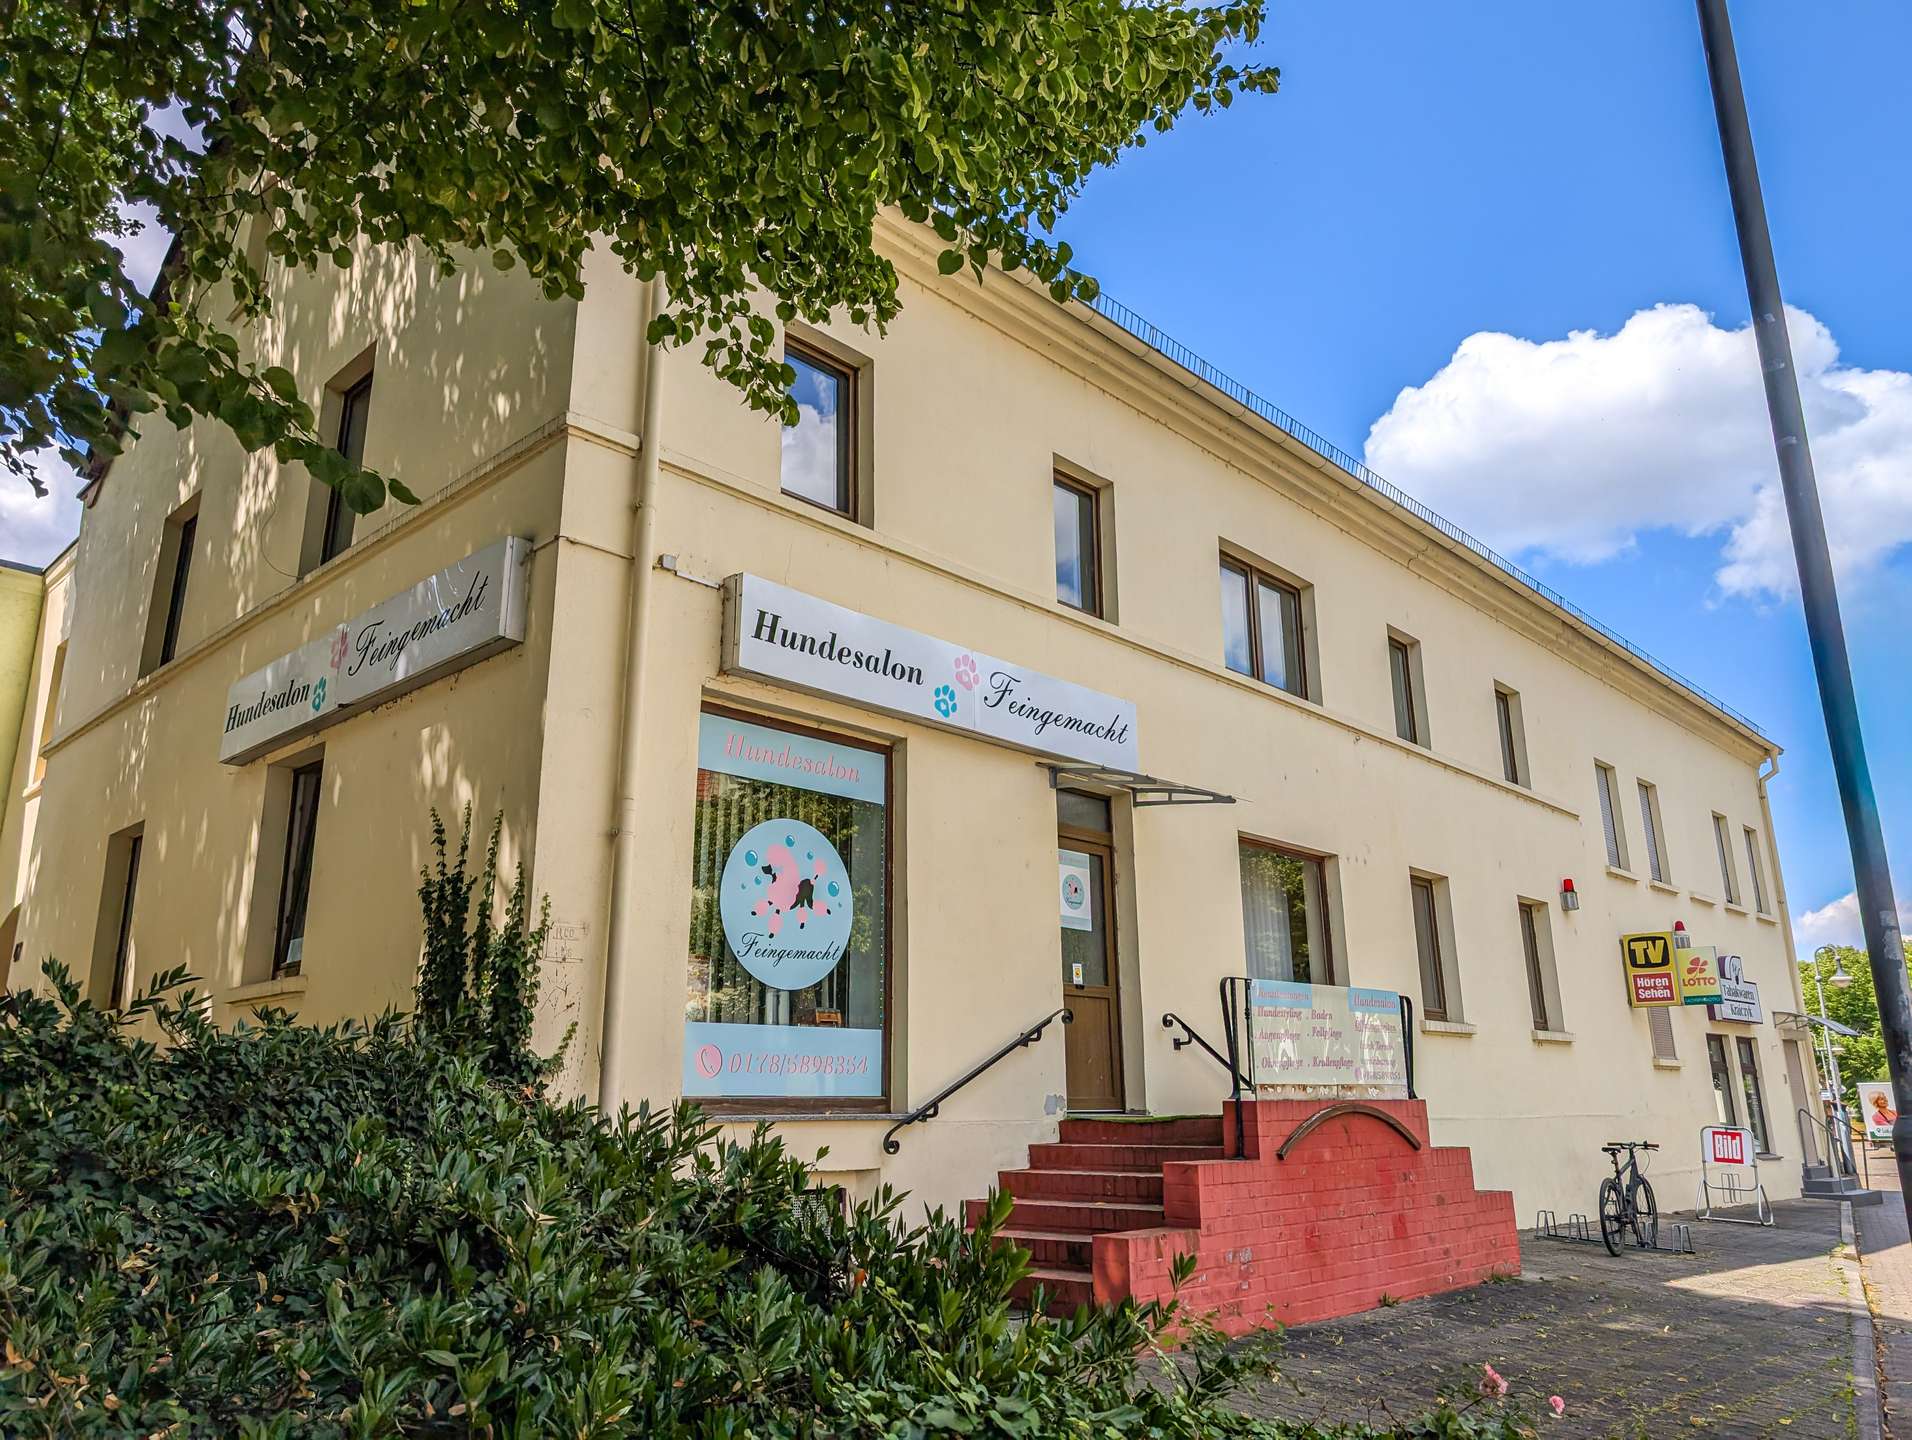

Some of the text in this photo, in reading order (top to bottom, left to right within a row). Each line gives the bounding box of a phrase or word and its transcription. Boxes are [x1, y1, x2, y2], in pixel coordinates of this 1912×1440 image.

[224, 570, 489, 733] Hundesalon Feingemacht
[751, 609, 1128, 745] Hundesalon Feingemacht
[724, 733, 861, 783] Hundesalon
[737, 931, 840, 968] Feingemacht
[1630, 939, 1665, 965] TV
[1638, 988, 1671, 999] Sehen
[1682, 977, 1717, 987] LOTTO
[1713, 1133, 1743, 1160] Bild
